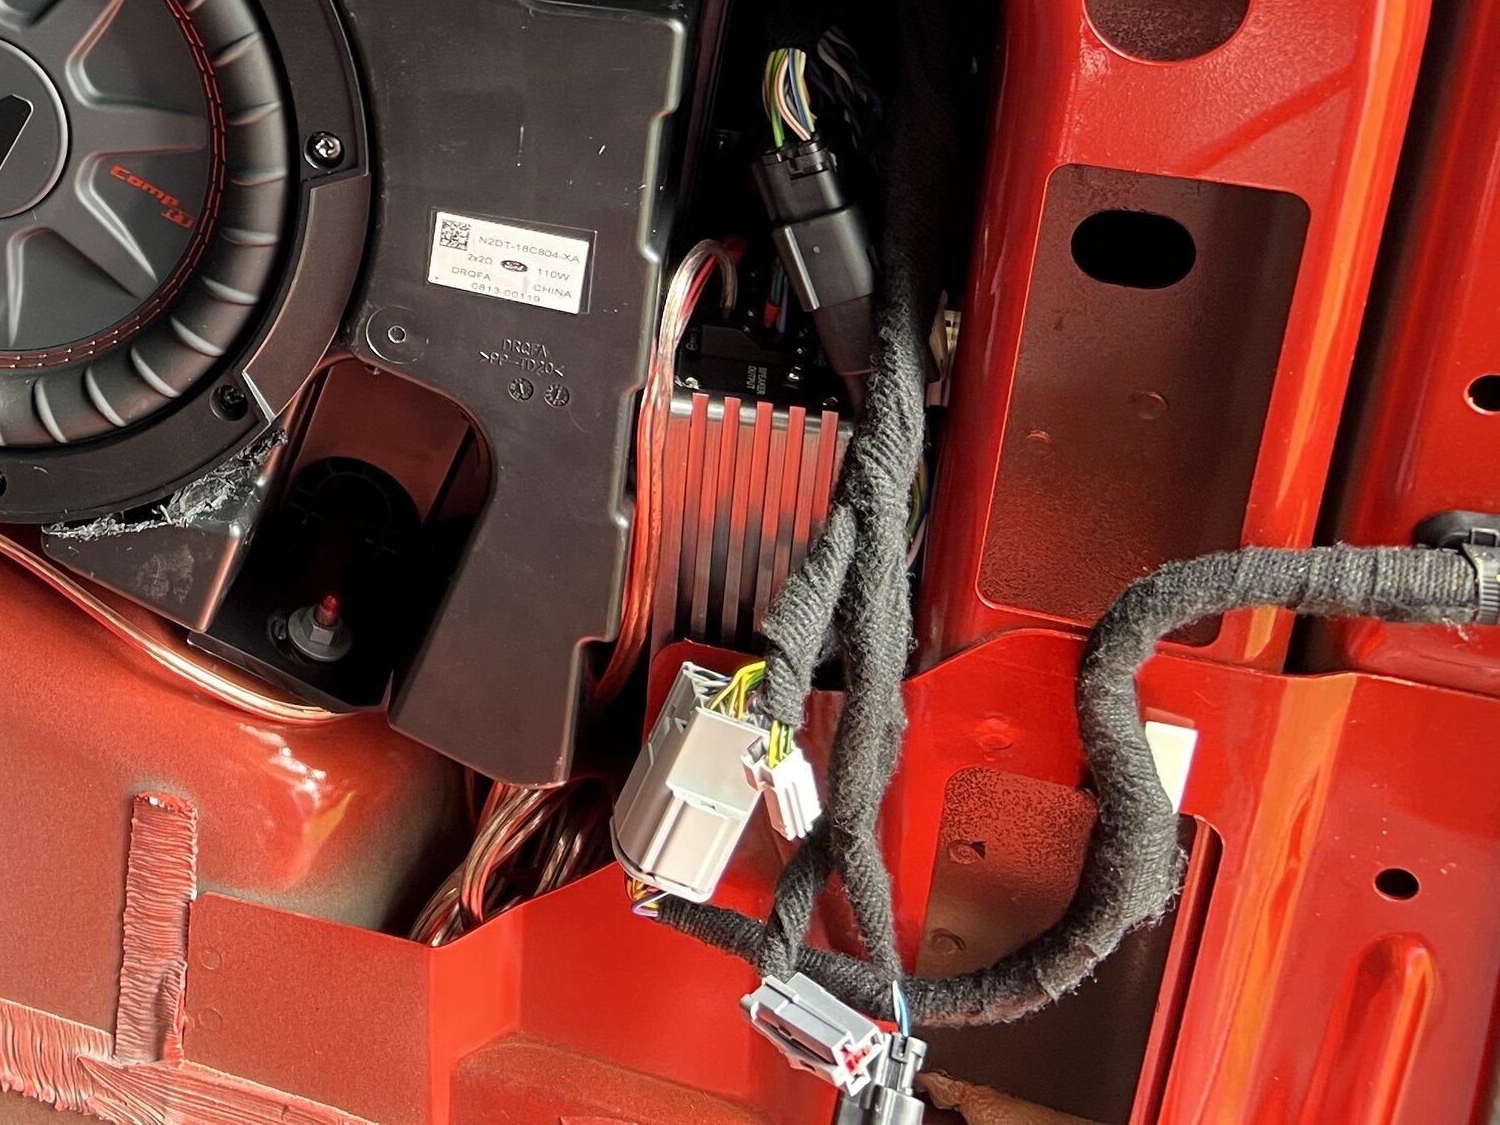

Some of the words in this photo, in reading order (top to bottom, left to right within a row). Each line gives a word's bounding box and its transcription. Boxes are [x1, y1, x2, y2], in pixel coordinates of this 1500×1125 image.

[110, 165, 180, 207] Comp
[451, 265, 492, 283] DRQFA
[533, 283, 573, 300] CHINA
